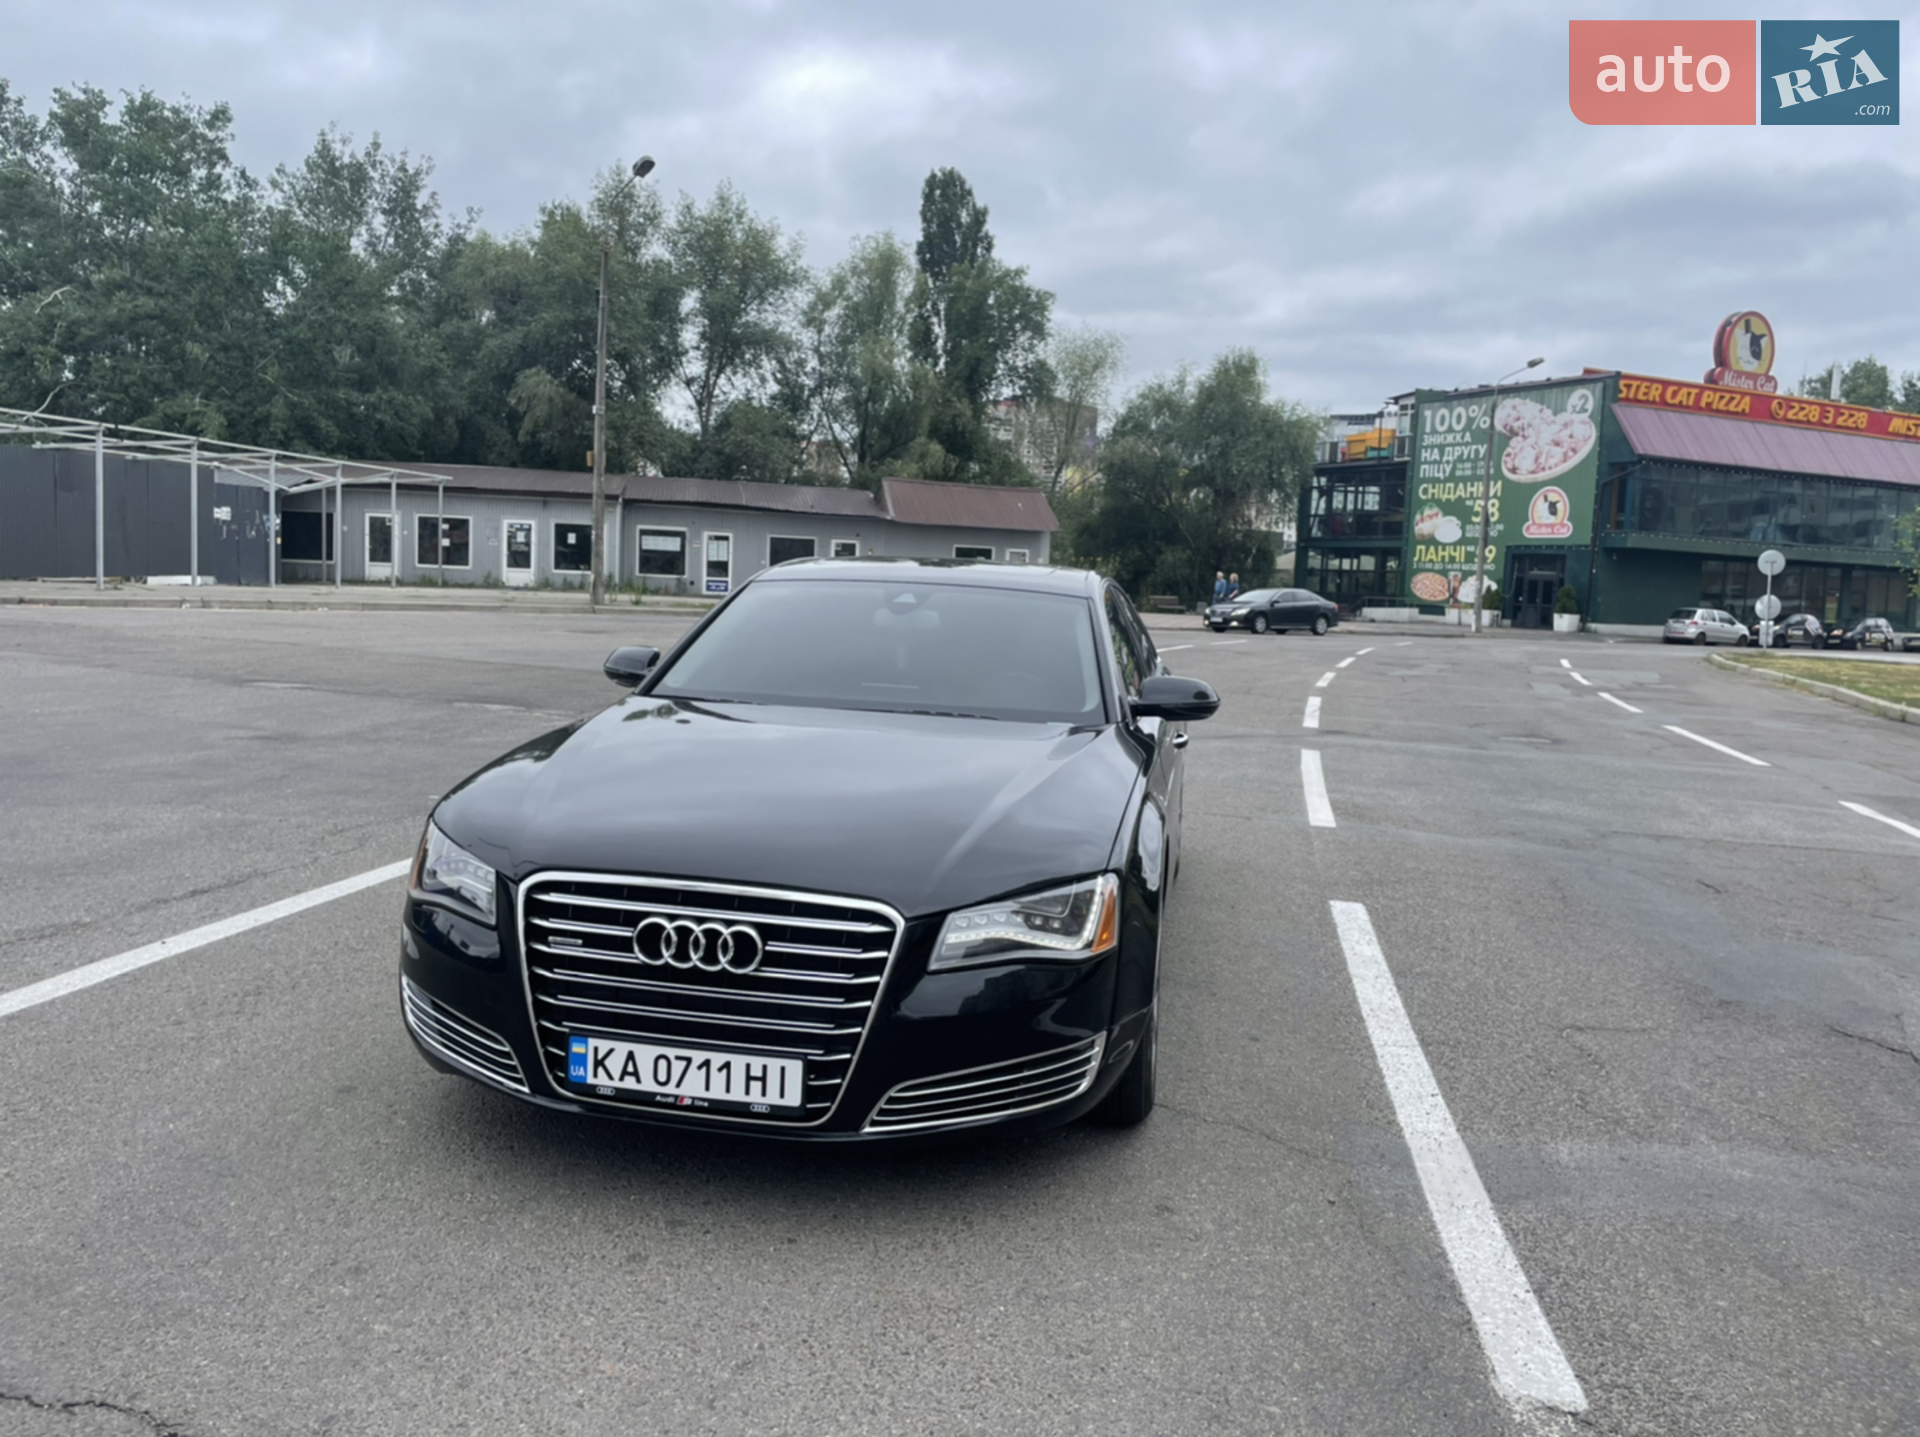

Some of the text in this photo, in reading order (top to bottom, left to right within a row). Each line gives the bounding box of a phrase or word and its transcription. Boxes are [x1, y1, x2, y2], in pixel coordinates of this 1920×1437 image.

[1719, 370, 1776, 393] Mister Cat
[1665, 386, 1700, 408] CAT
[1700, 390, 1751, 414] PIZZA
[1787, 401, 1820, 423] 228
[1822, 404, 1834, 425] 3
[1836, 408, 1868, 429] 228
[1423, 404, 1491, 434] 100%
[1422, 431, 1472, 447] ЗНИЖКА
[1421, 444, 1487, 464] НА ДРУГУ
[1420, 463, 1453, 480] ПІЦУ
[1471, 499, 1500, 523] 58
[1413, 545, 1465, 563] ЛАНЧІ
[1474, 545, 1497, 563] 9
[570, 1065, 585, 1077] UA
[592, 1045, 786, 1099] KA 0711 HI
